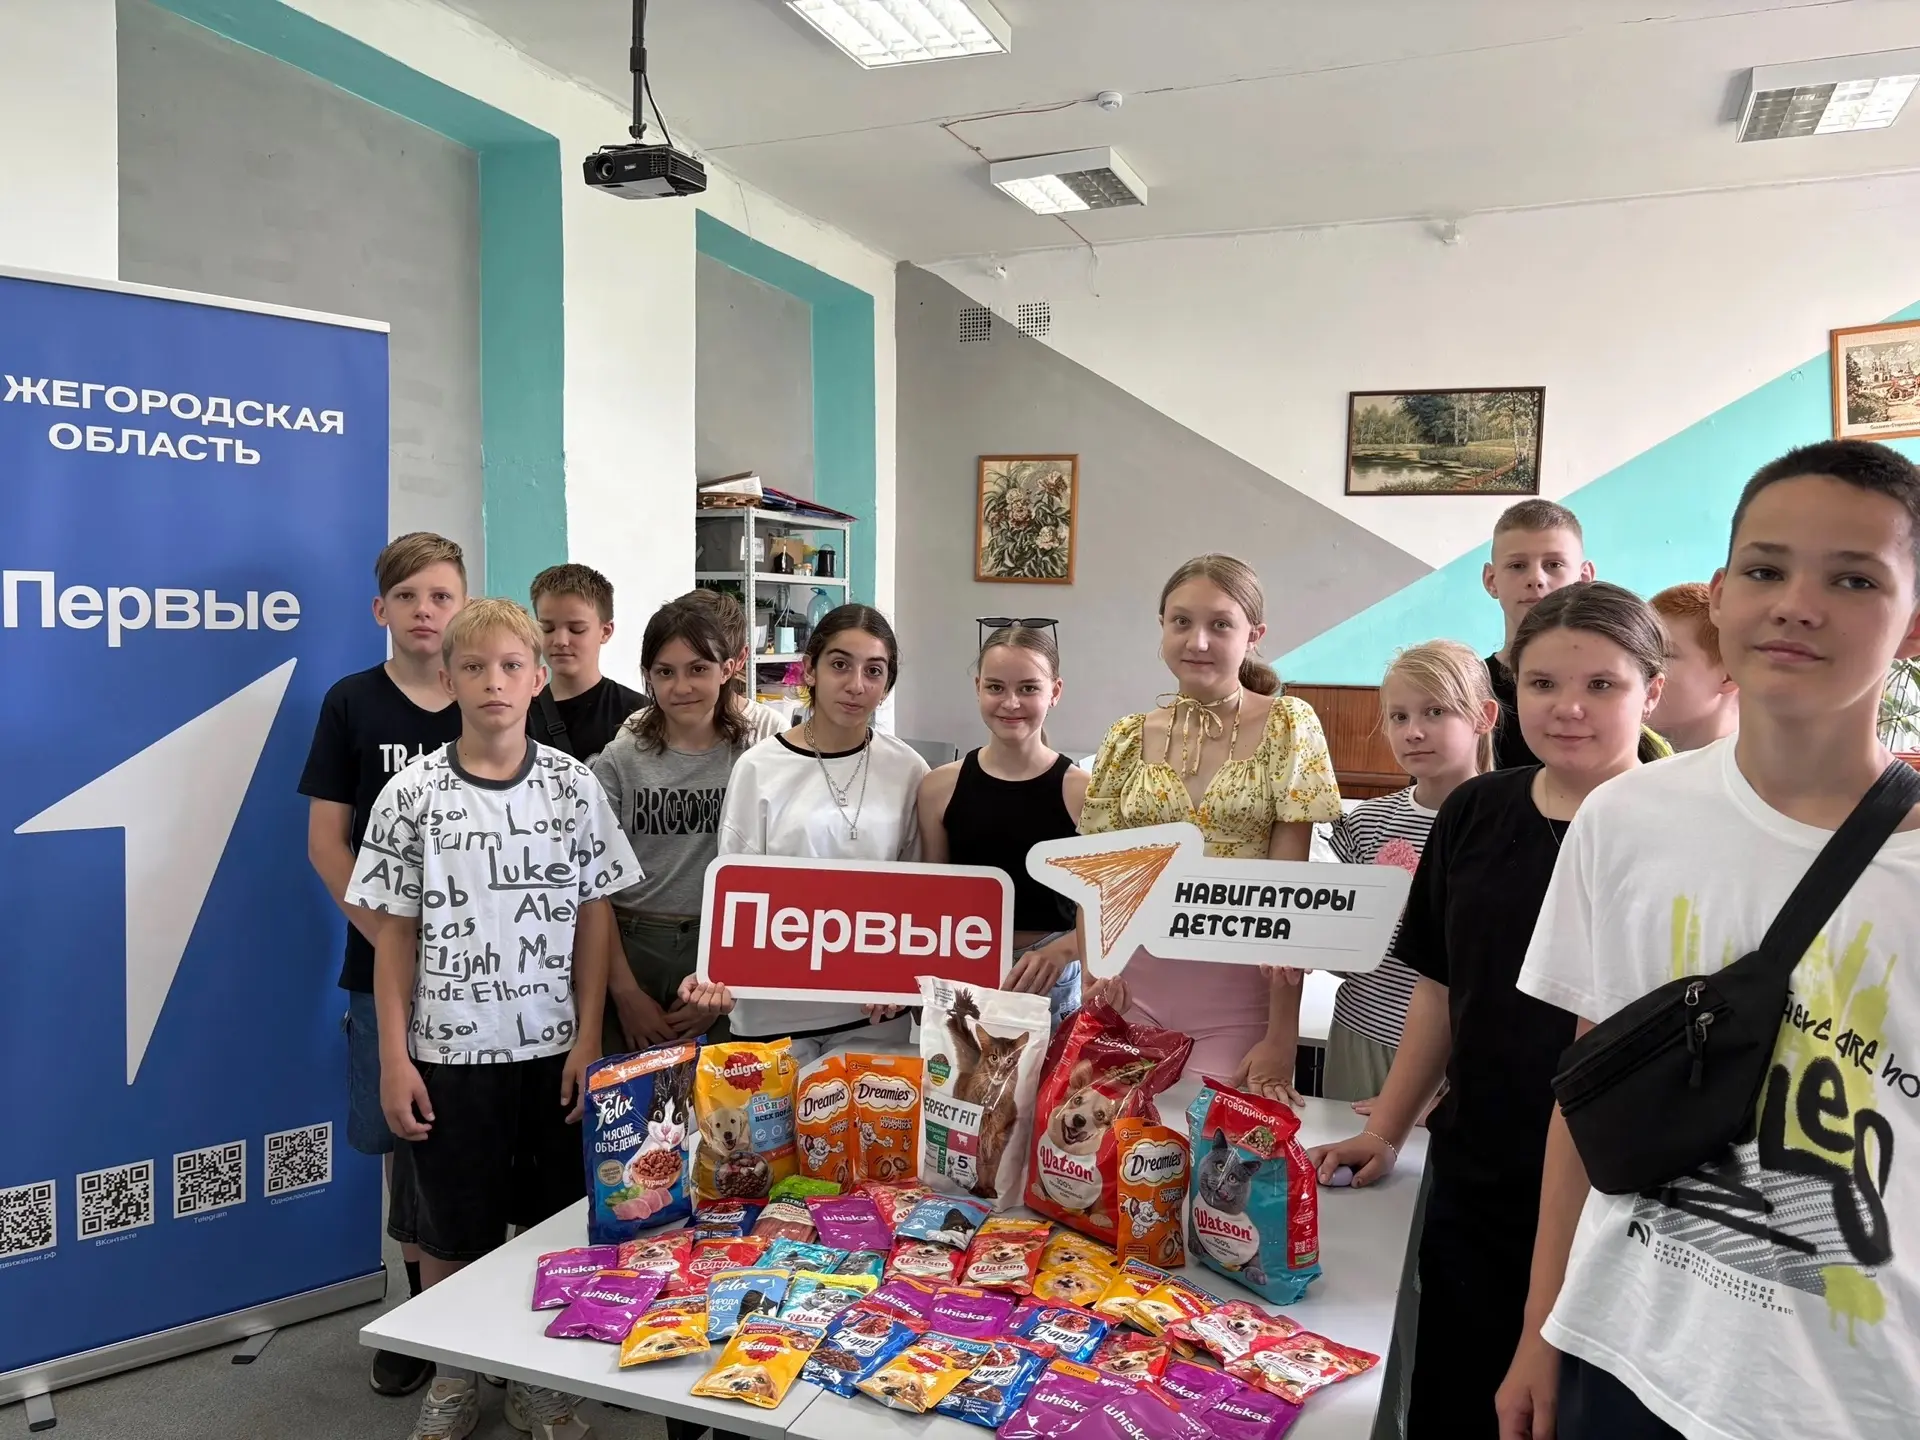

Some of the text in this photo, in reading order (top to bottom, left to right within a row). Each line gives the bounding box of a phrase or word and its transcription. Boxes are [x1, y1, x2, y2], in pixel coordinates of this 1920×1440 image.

[4, 375, 344, 434] ЖЕГОРОДСКАЯ
[49, 423, 260, 465] ОБЛАСТЬ
[3, 570, 301, 647] Первые
[667, 799, 721, 821] NEW YOR
[488, 846, 577, 890] Luke
[1174, 882, 1356, 911] НАВИГАТОРЫ
[721, 891, 993, 971] Первые
[1168, 912, 1291, 940] ДЕТСТВА
[472, 980, 549, 1003] Ethan
[714, 1060, 772, 1079] Pedigree
[858, 1083, 911, 1101] Dreamies
[595, 1096, 634, 1132] Felix
[754, 1098, 788, 1114] ЩЕНКО
[924, 1098, 978, 1127] ERFECT FIT
[1222, 1098, 1277, 1126] ГОВЯДИНОЙ
[755, 1113, 773, 1122] ВСЕХ
[603, 1122, 635, 1141] МЯСНОЕ
[595, 1133, 642, 1153] ОБЪЕДЕНИЕ
[957, 1155, 968, 1169] 5
[1040, 1145, 1094, 1182] Watson
[1131, 1152, 1182, 1177] Dreamies
[193, 1211, 228, 1224] Telegram
[822, 1214, 876, 1222] whiskas
[1195, 1206, 1253, 1241] Watson
[96, 1232, 137, 1247] ВКонтакте
[545, 1264, 604, 1275] whiskas
[898, 1256, 949, 1268] Watson
[973, 1264, 1024, 1276] Watson
[1654, 1254, 1687, 1270] RIVER
[712, 1279, 751, 1297] felix
[1125, 1277, 1152, 1291] Pedi
[1710, 1272, 1773, 1302] ADVENTURE
[1711, 1265, 1775, 1295] CHALLENGE
[581, 1290, 637, 1306] whiskas
[874, 1291, 923, 1318] whiskas
[787, 1313, 832, 1323] Wats
[934, 1306, 993, 1321] whiskas
[739, 1341, 792, 1354] Pedigree
[1263, 1352, 1318, 1378] Watson
[1160, 1376, 1201, 1400] hiskas
[1103, 1404, 1150, 1440] whisk
